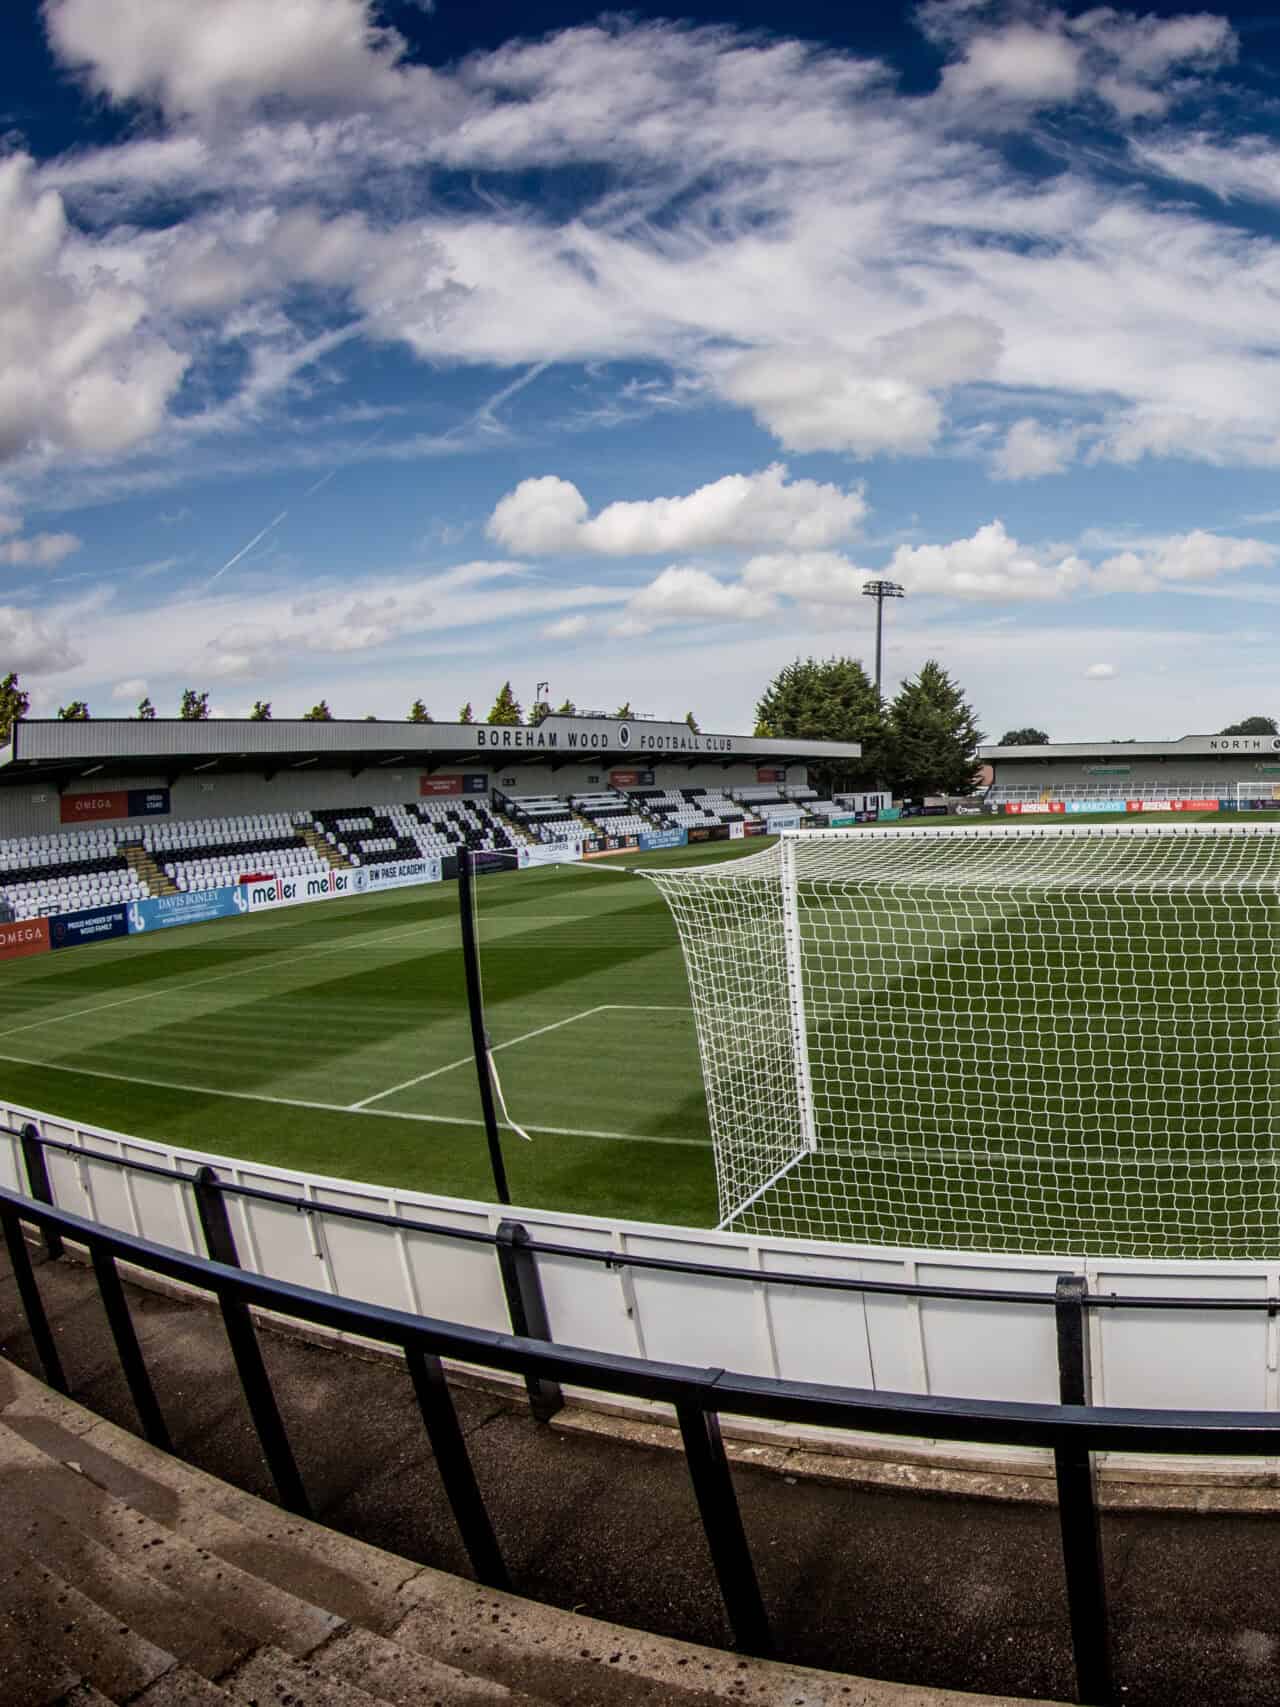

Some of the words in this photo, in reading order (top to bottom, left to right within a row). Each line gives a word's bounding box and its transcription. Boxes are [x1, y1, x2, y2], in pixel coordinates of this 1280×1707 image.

[478, 730, 557, 747] BOREHAM
[568, 733, 608, 748] WOOD
[640, 735, 700, 750] FOOTBALL
[706, 738, 732, 751] CLUB
[1210, 740, 1260, 749] NORTH
[75, 799, 112, 811] OMEGA
[381, 866, 397, 878] PASE
[399, 863, 426, 877] ACADEMY
[307, 871, 348, 895] meller
[252, 879, 296, 904] meller
[159, 897, 185, 909] DAVIS
[0, 927, 42, 945] OMEGA
